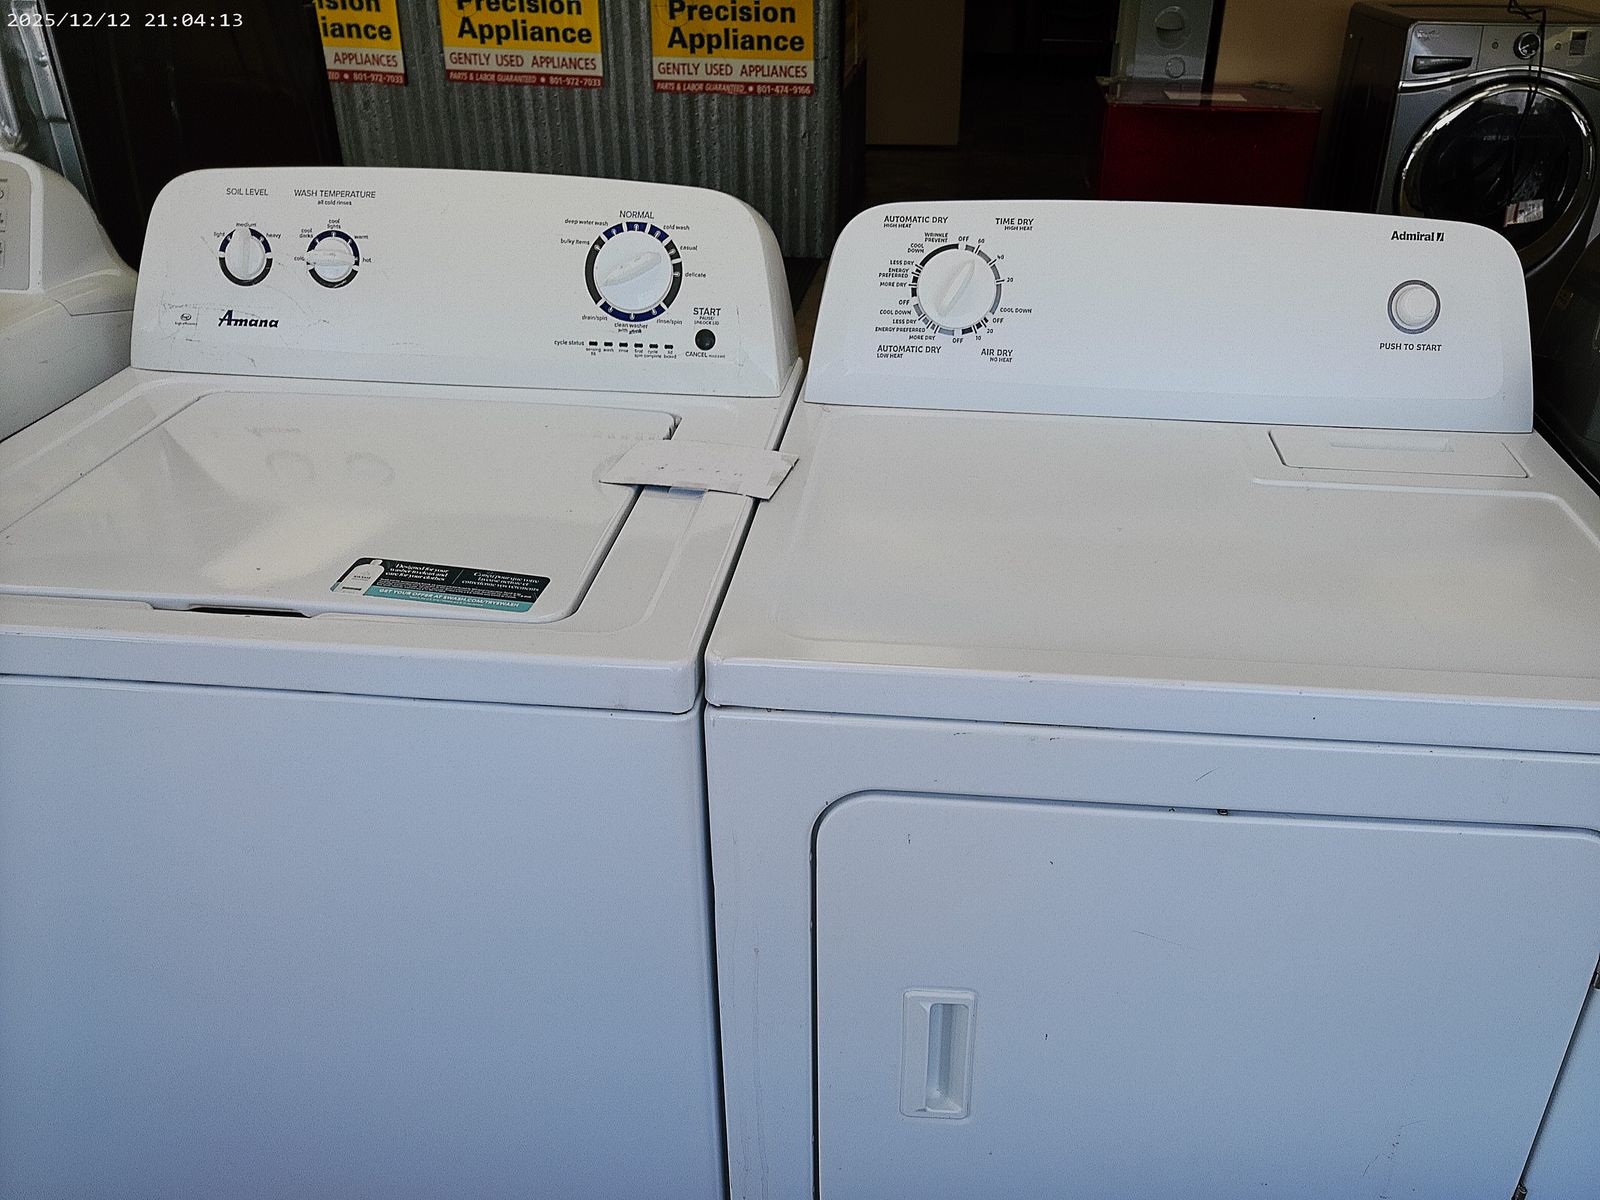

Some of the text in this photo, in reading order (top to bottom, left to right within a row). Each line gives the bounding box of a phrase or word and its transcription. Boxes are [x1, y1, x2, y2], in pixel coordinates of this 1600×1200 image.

[668, 0, 796, 23] Precision
[457, 16, 592, 45] Appliance
[667, 26, 805, 55] Appliance
[333, 52, 398, 68] APPLIANCES
[450, 52, 596, 70] GENTLY USED APPLIANCES
[657, 62, 807, 78] GENTLY USED APPLIANCES
[353, 72, 403, 84] 801-972-7033
[549, 77, 601, 87] 801-972-7033
[756, 85, 811, 94] 801-474-9166
[226, 188, 268, 196] SOIL LEVEL
[294, 189, 376, 198] WASH TEMPERATURE
[619, 210, 654, 219] NORMAL
[883, 215, 949, 224] AUTOMATIC DRY
[1017, 218, 1034, 226] DRY
[1391, 230, 1434, 242] Admiral
[693, 307, 721, 316] START
[217, 309, 279, 328] Amana
[877, 345, 942, 354] AUTOMATIC DRY
[1379, 342, 1402, 350] PUSH
[1403, 343, 1415, 351] TO
[996, 349, 1013, 357] DRY
